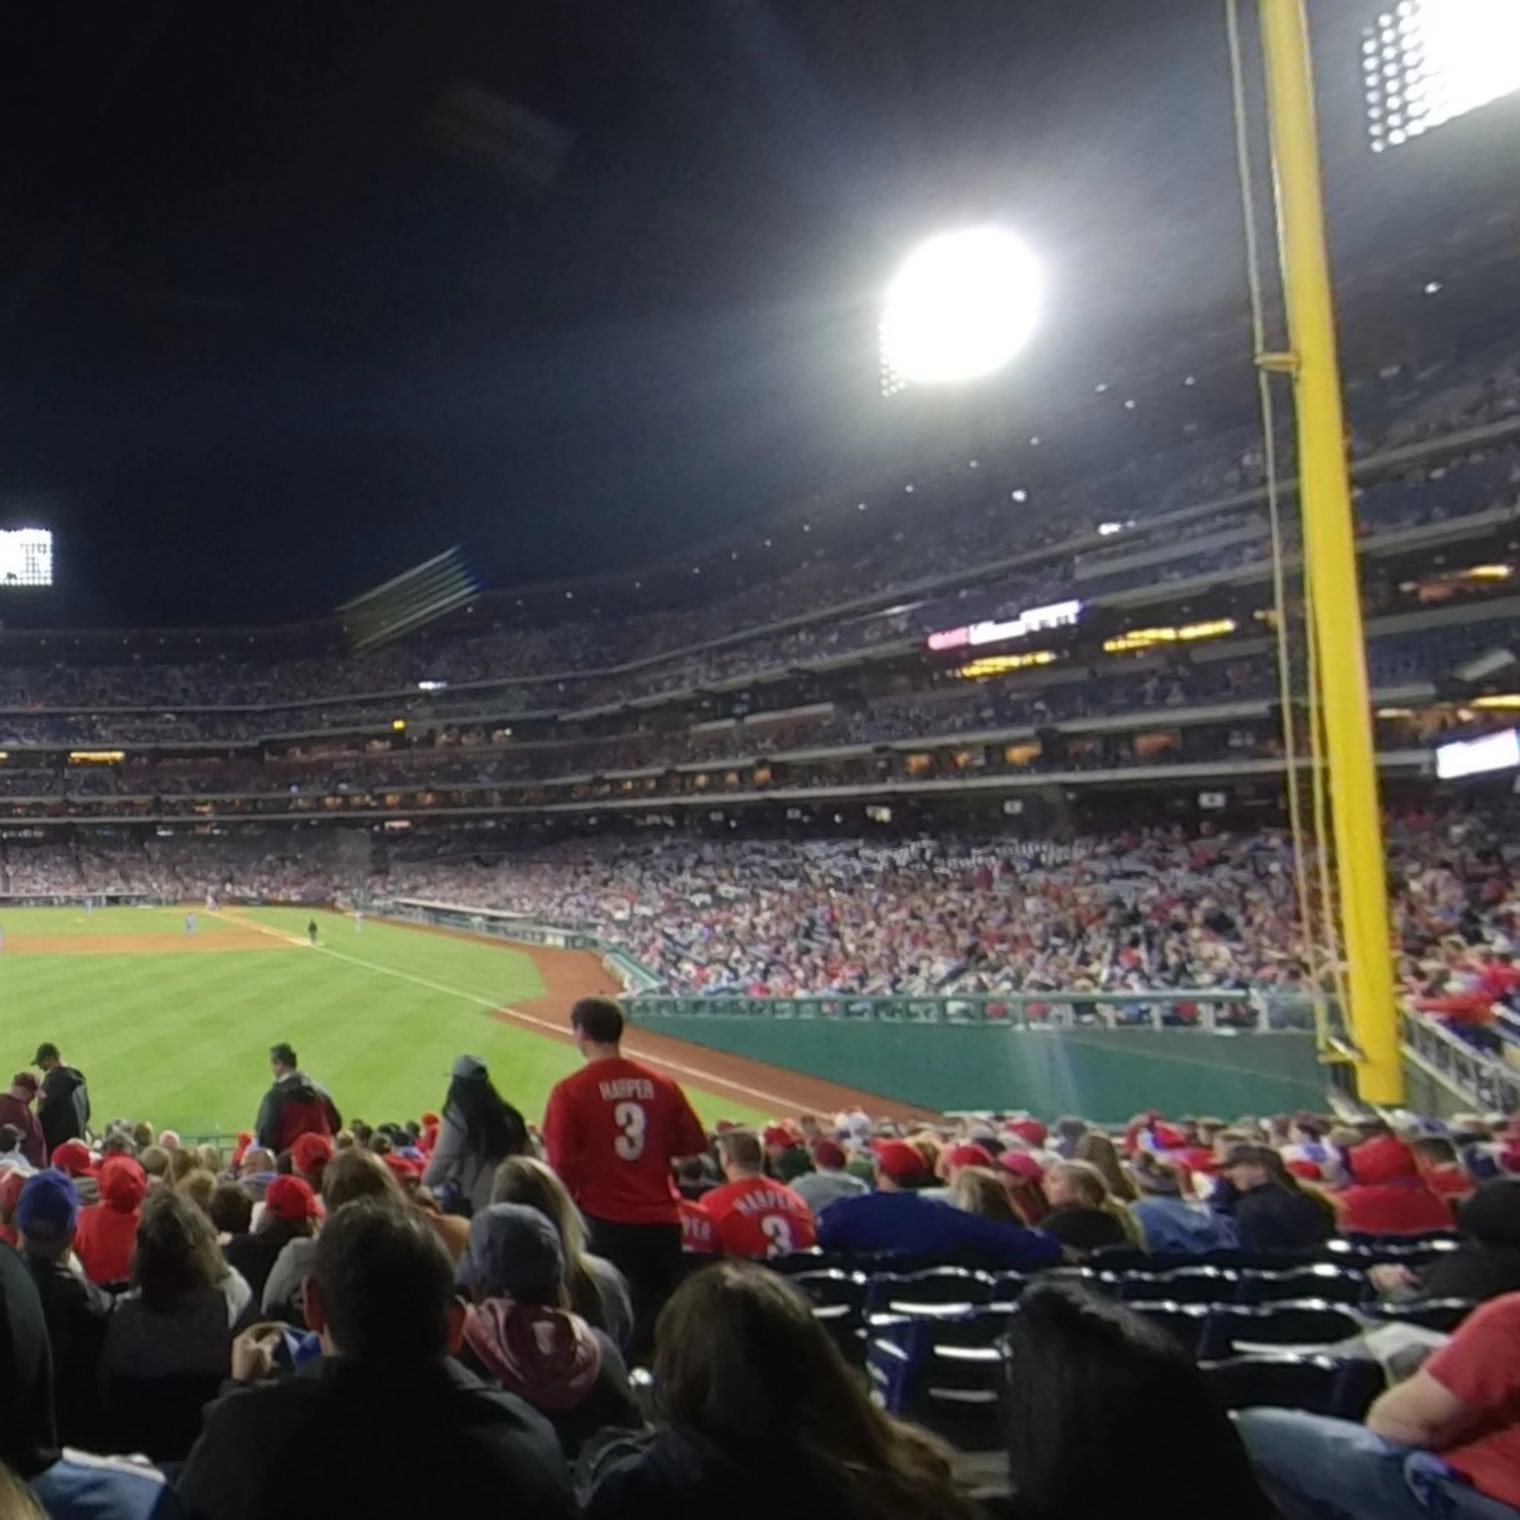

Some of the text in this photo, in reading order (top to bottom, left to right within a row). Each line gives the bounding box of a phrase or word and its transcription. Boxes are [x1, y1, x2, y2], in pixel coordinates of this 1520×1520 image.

[599, 1079, 654, 1100] HARPER
[614, 1102, 645, 1160] 3
[733, 1190, 794, 1216] HARPER
[762, 1215, 793, 1260] 3
